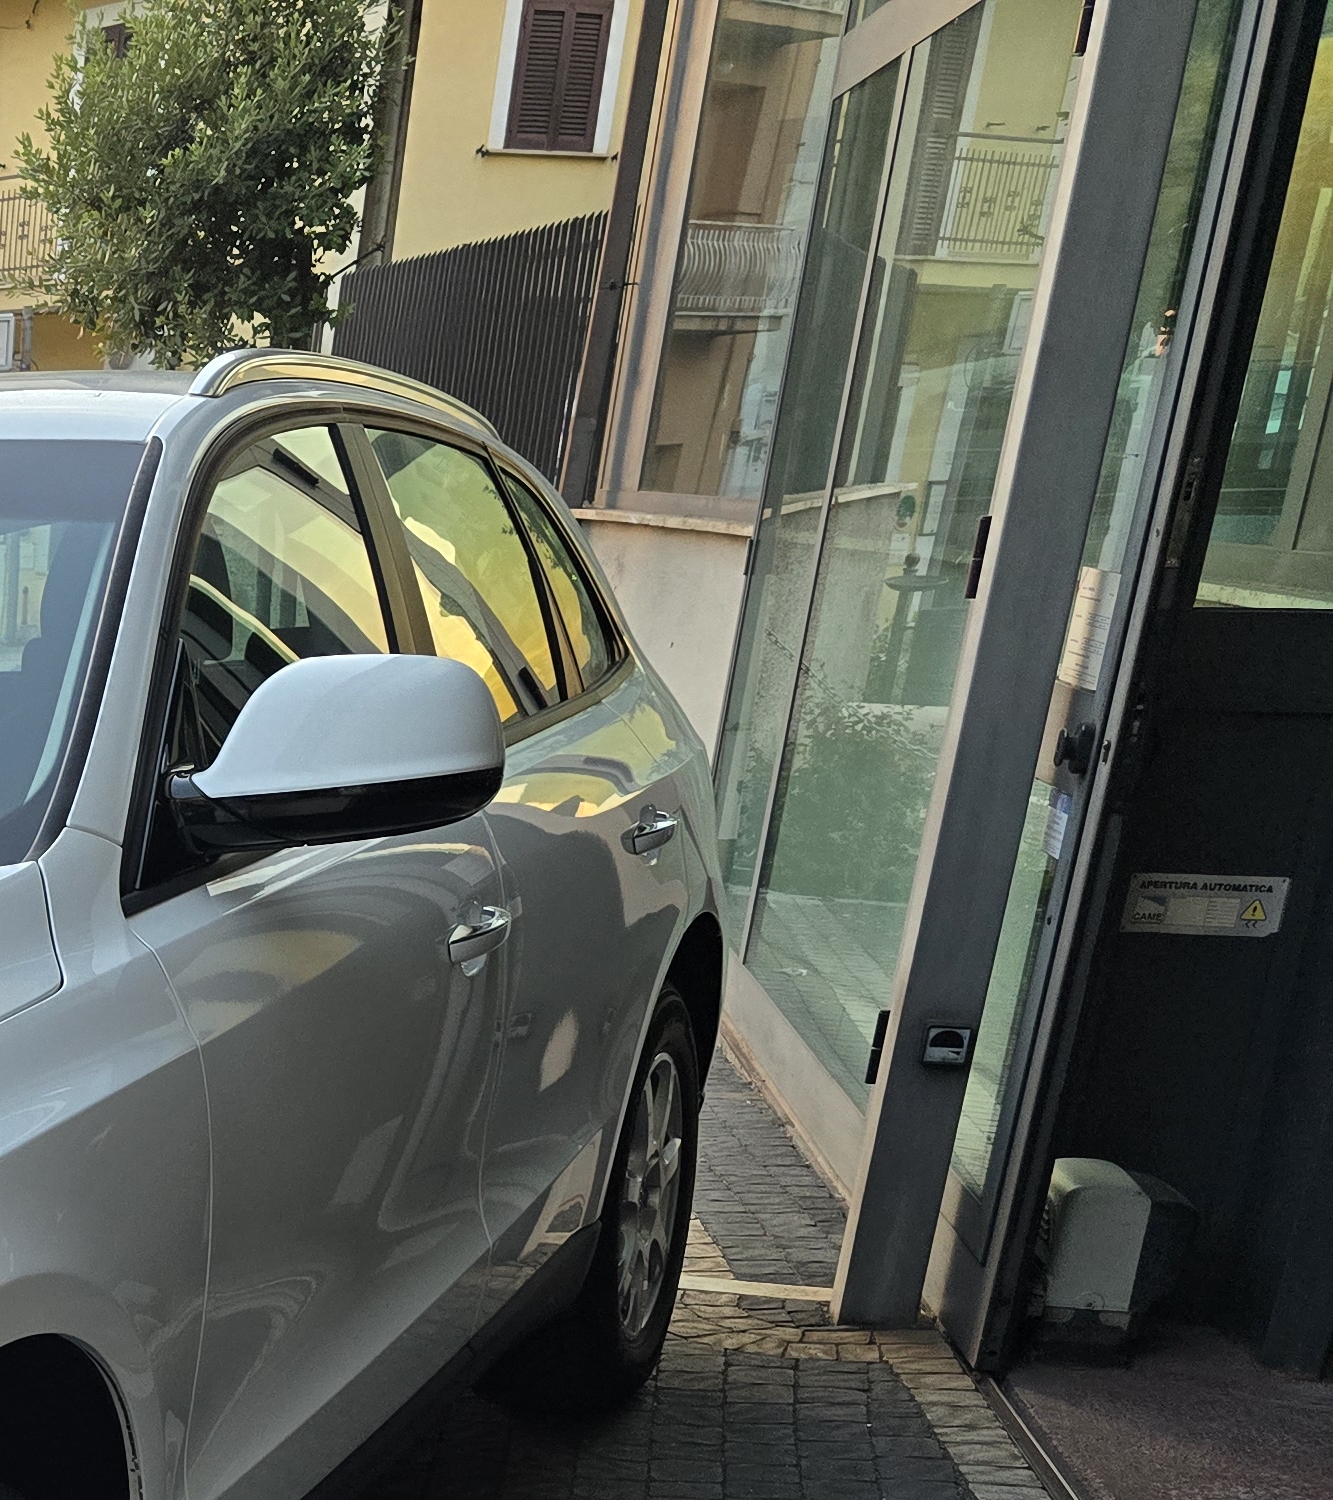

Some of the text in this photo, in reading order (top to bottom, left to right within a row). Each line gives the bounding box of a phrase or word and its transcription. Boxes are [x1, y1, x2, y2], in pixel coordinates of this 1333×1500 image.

[1139, 880, 1273, 893] APERTURA AUTOMATICA
[1133, 912, 1162, 922] CAME
